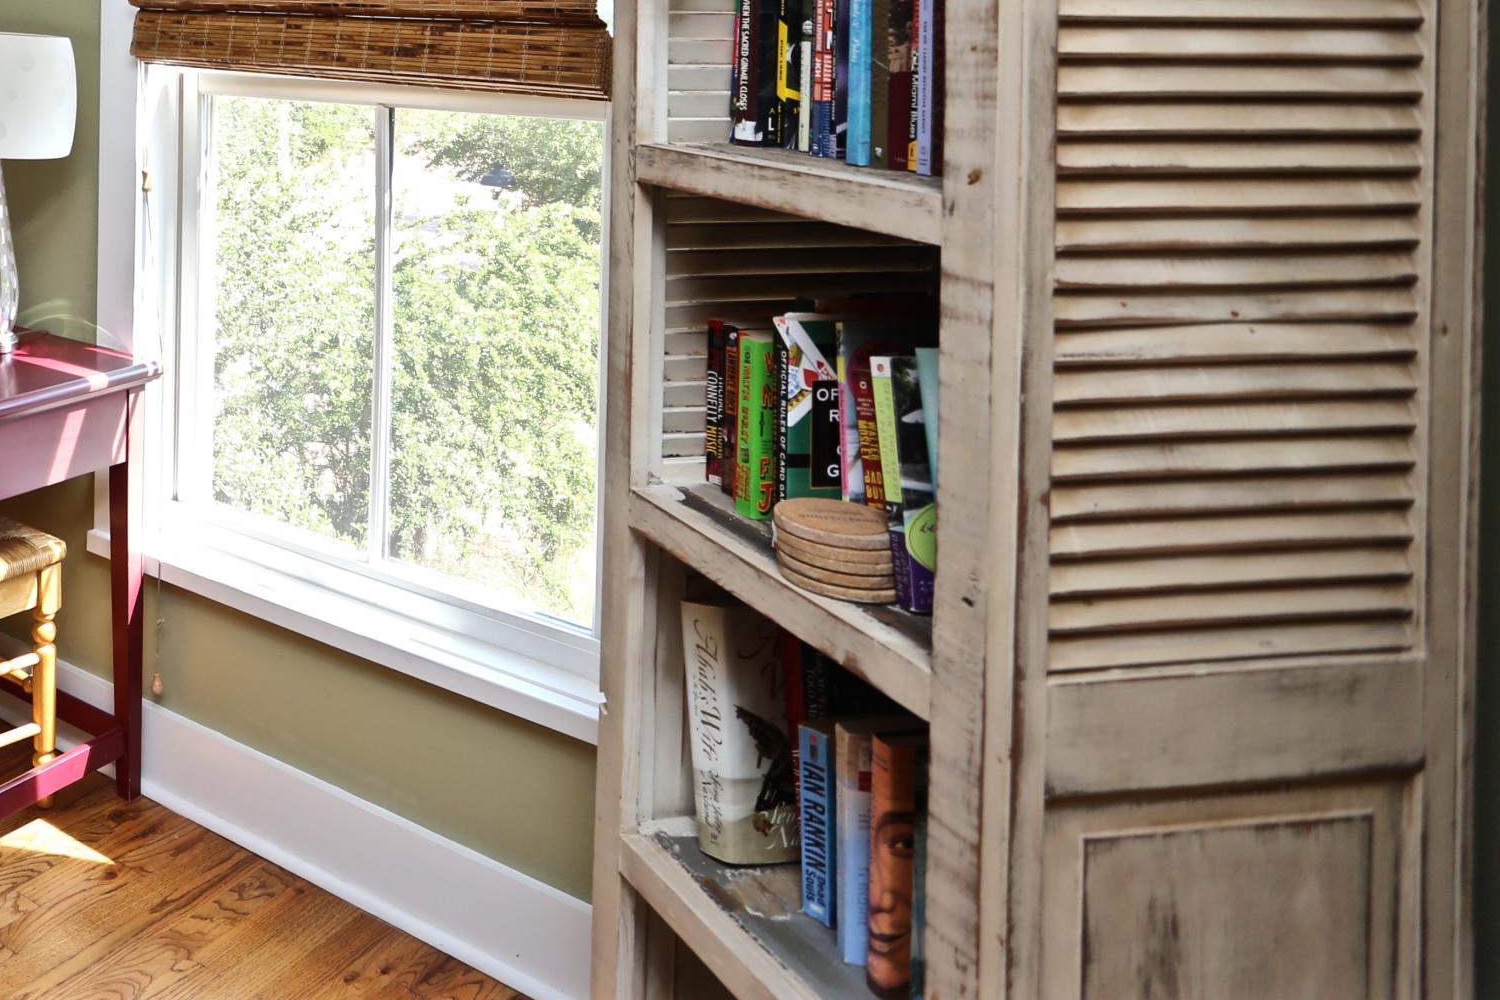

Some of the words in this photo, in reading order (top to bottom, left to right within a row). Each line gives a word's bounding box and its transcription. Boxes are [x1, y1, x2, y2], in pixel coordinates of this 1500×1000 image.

[742, 17, 750, 30] THE
[741, 30, 750, 57] SACRED
[738, 86, 748, 112] CLOSES
[911, 75, 920, 108] Miami
[909, 111, 918, 139] Blues
[707, 371, 718, 423] CONNELLY
[707, 425, 718, 457] MUSIC
[780, 435, 787, 450] OF
[857, 419, 869, 460] MOSLEY
[868, 421, 880, 461] WALTER
[694, 618, 718, 703] Ahab's
[699, 706, 723, 762] Wife
[803, 761, 826, 797] IAN
[803, 798, 827, 875] RANKIN
[805, 868, 817, 903] Souls
[817, 875, 827, 908] Dead
